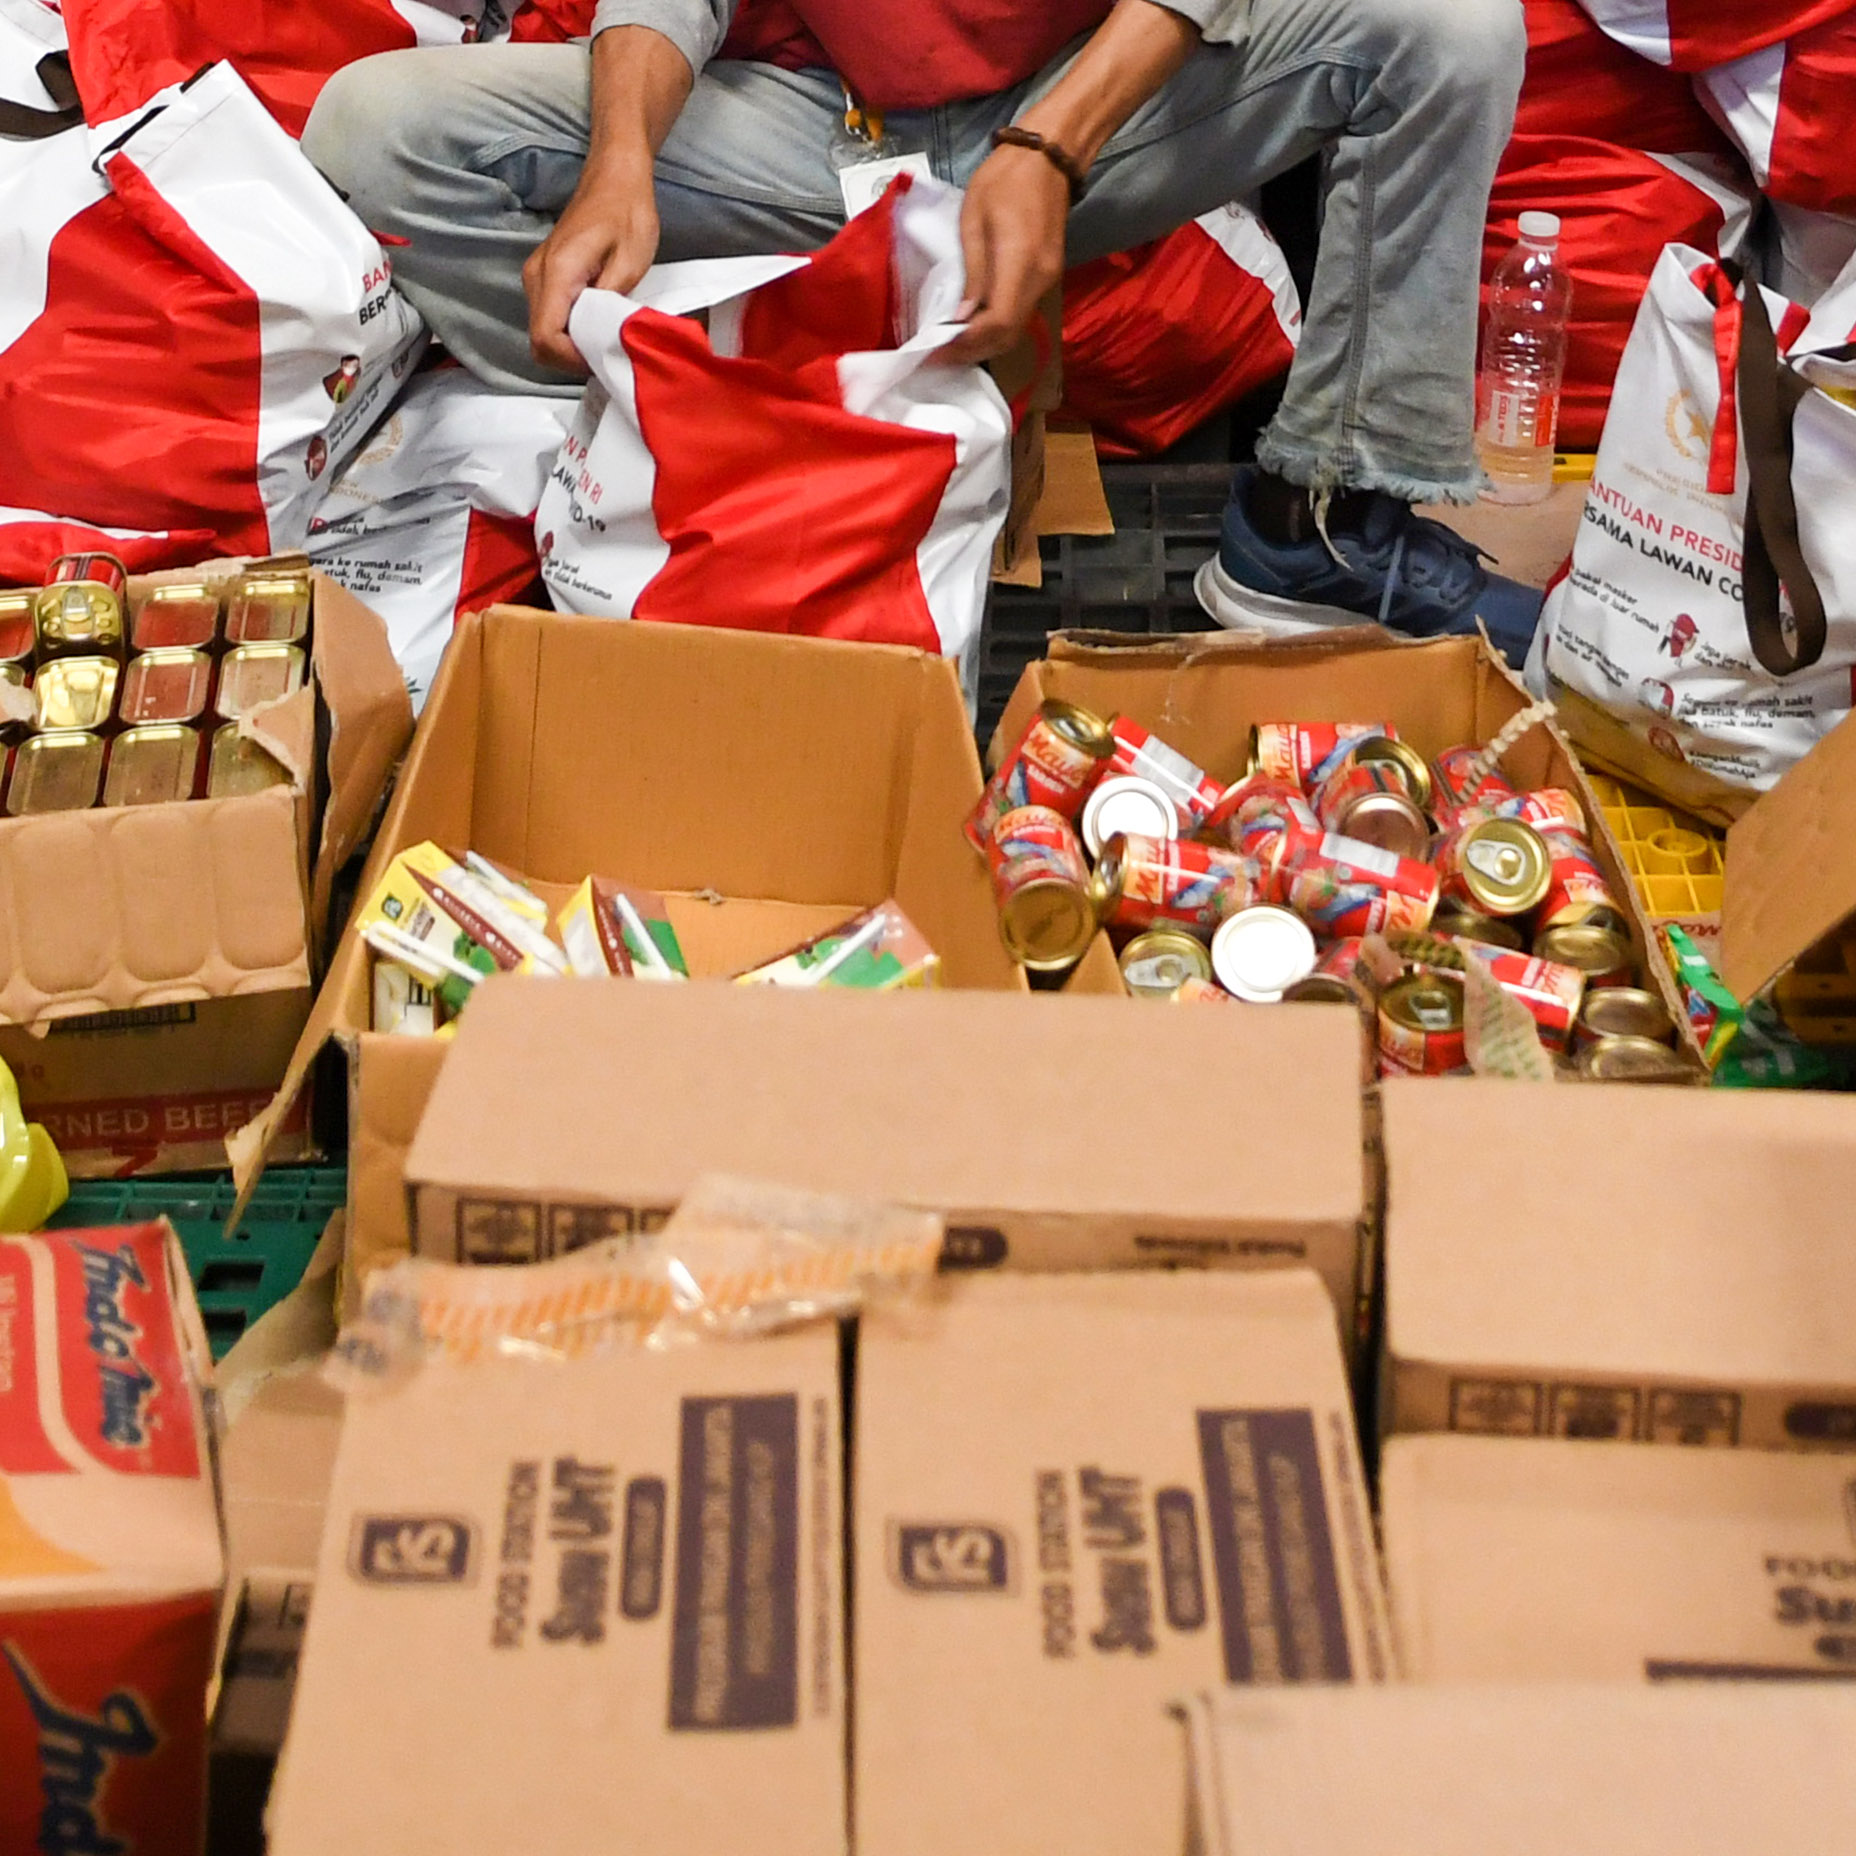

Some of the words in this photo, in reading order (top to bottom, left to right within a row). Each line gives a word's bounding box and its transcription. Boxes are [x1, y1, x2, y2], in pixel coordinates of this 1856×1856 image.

[588, 483, 605, 505] RI
[1590, 478, 1664, 535] ANTUAN
[1669, 523, 1744, 573] PRESID
[355, 559, 392, 572] rumah
[1583, 499, 1634, 550] RSAMA
[1639, 537, 1714, 587] LAWAN
[1603, 579, 1639, 607] masker
[1631, 610, 1661, 634] rumah
[1701, 706, 1740, 720] batuk,
[1767, 706, 1816, 720] demam,
[1740, 718, 1774, 729] nafas
[1784, 695, 1814, 707] sakit
[46, 1104, 150, 1141] RNED
[500, 1460, 540, 1565] STATION
[549, 1453, 616, 1542] UHT
[1034, 1469, 1074, 1572] STATION
[1078, 1464, 1148, 1553] UHT
[491, 1572, 531, 1649] FOOD
[537, 1549, 612, 1647] Susu
[1040, 1581, 1077, 1661] FOOD
[1089, 1559, 1158, 1659] Susu
